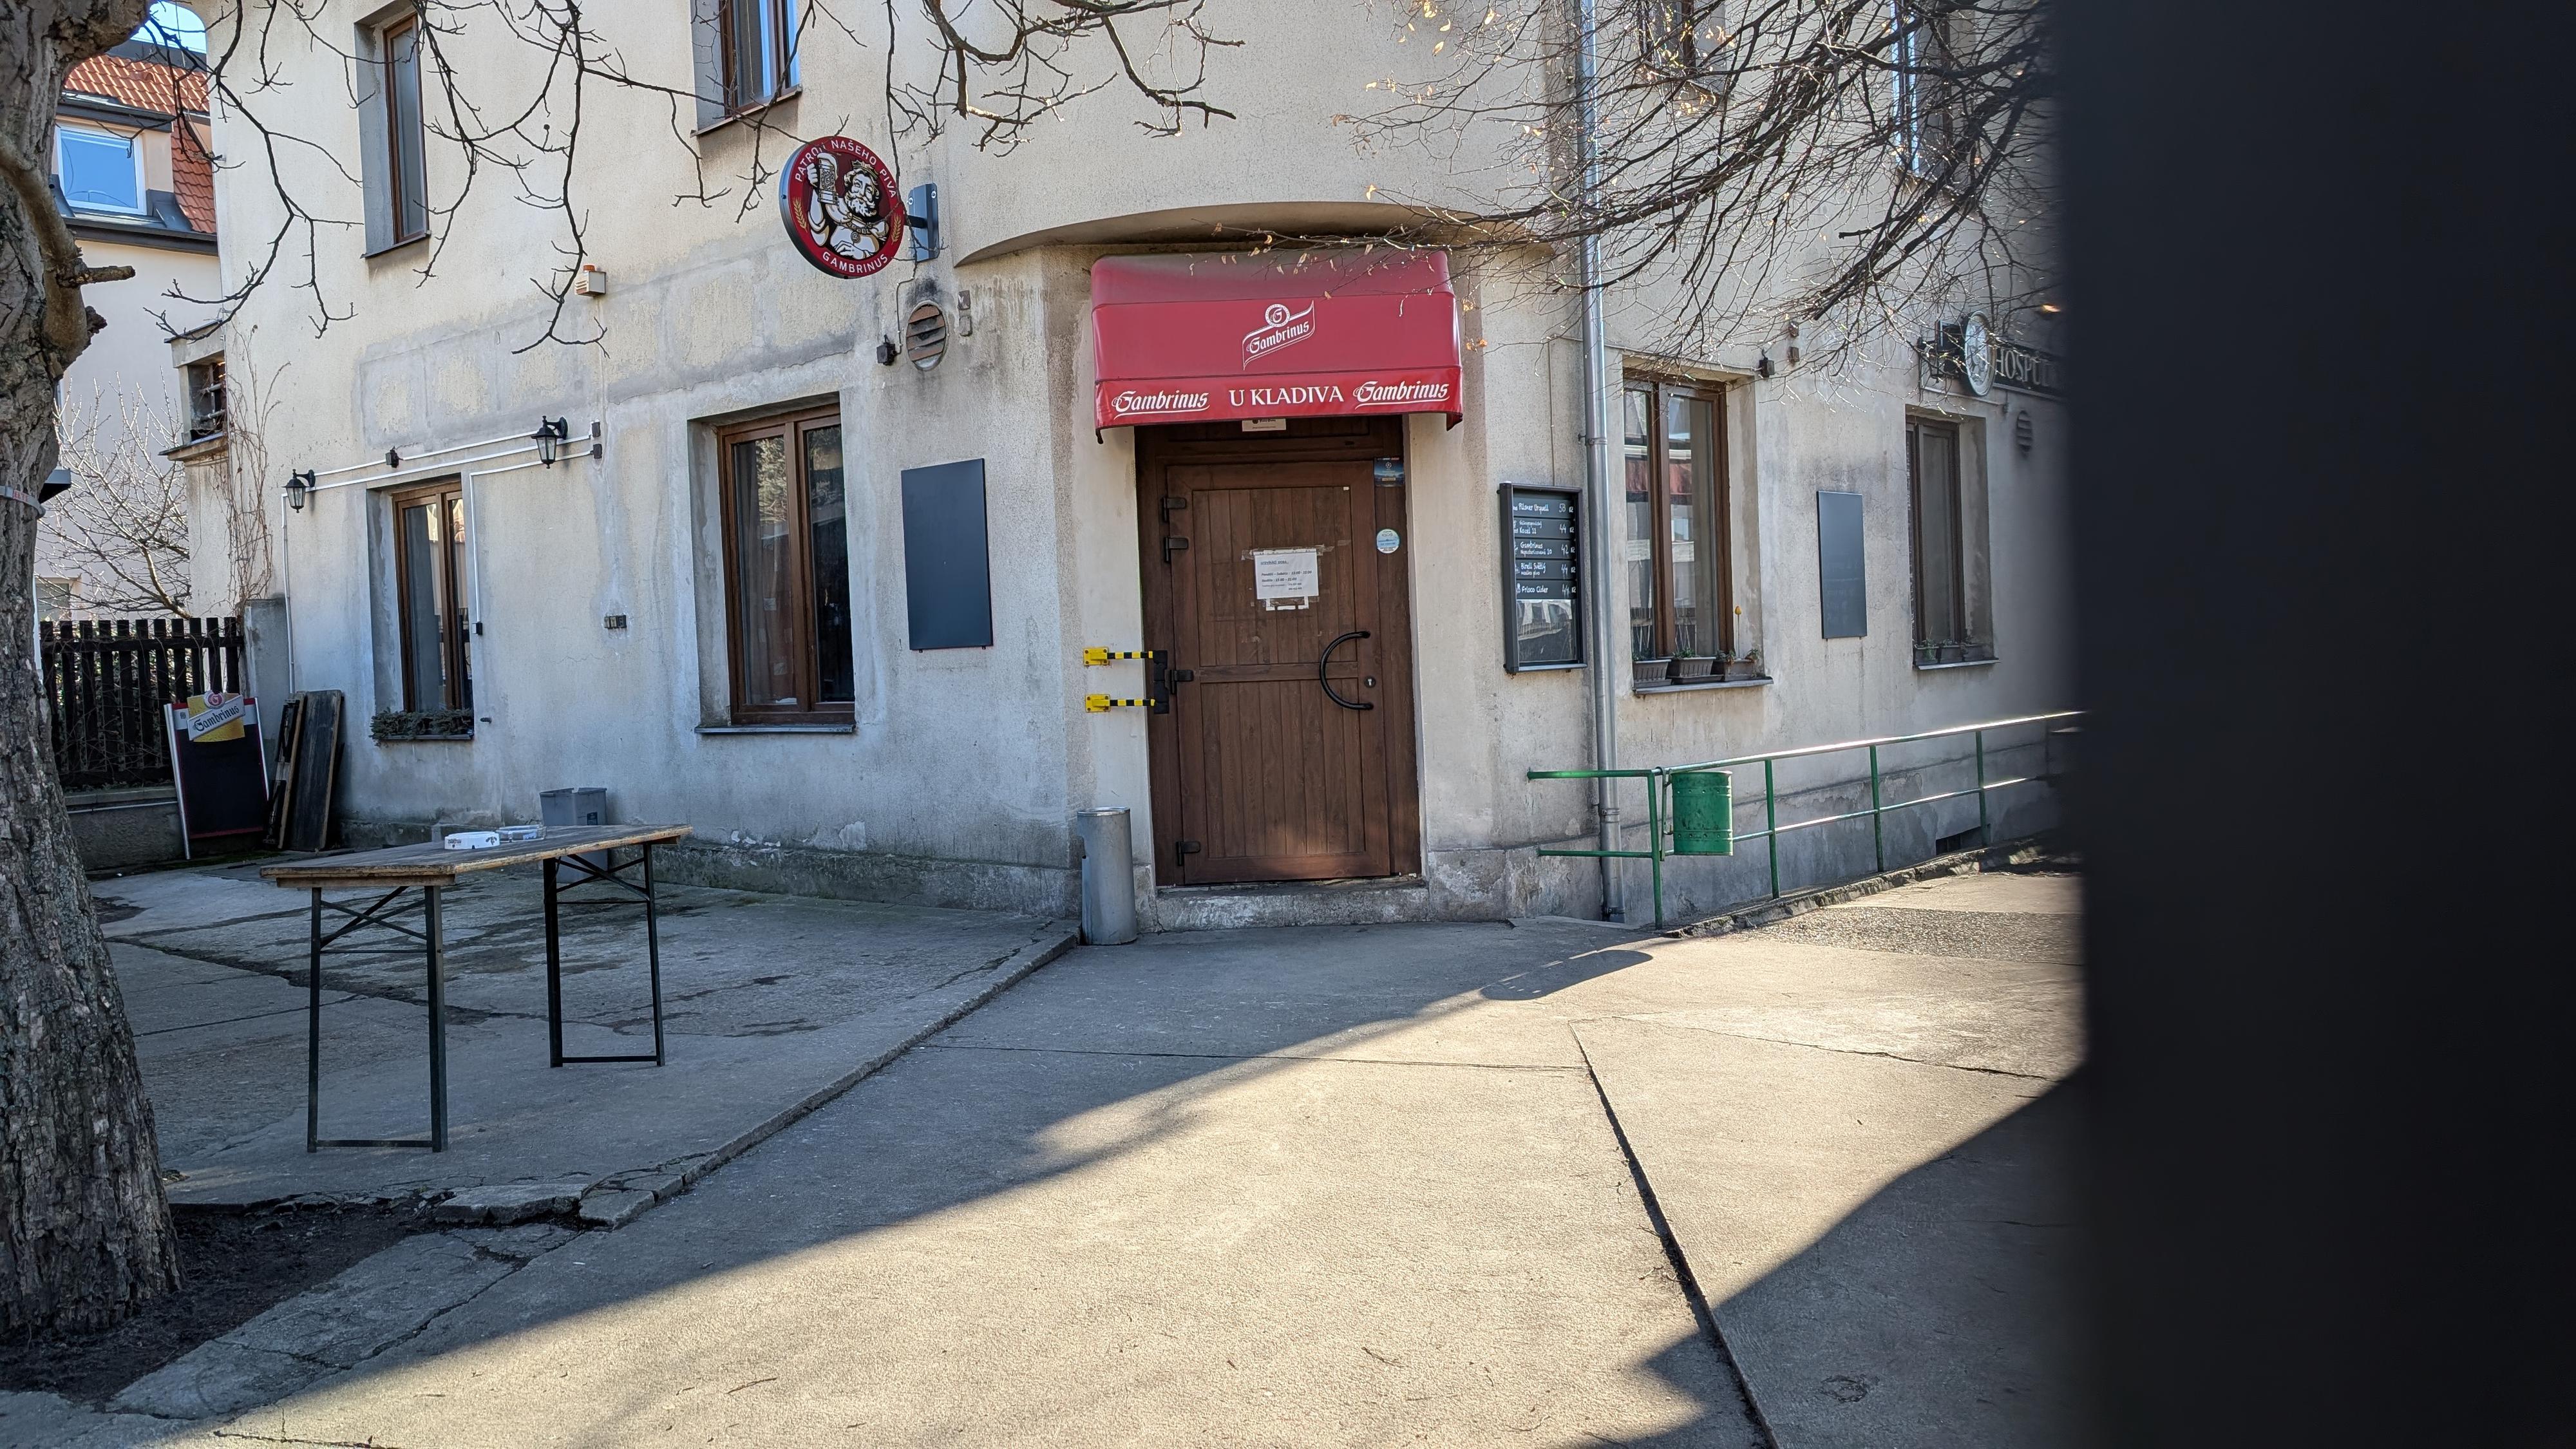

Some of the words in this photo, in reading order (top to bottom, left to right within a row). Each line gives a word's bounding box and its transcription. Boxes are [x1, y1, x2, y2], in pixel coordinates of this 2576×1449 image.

[831, 140, 876, 166] NAŠEHO
[879, 169, 897, 198] PIVA
[822, 251, 888, 274] GAMBRINUS
[1246, 321, 1310, 354] Gambrinus
[1111, 390, 1209, 412] Gambrinus
[1229, 389, 1245, 406] U
[1249, 386, 1345, 406] KLADIVA
[1352, 381, 1450, 402] Gambrinus
[193, 705, 240, 732] Gambrinus
